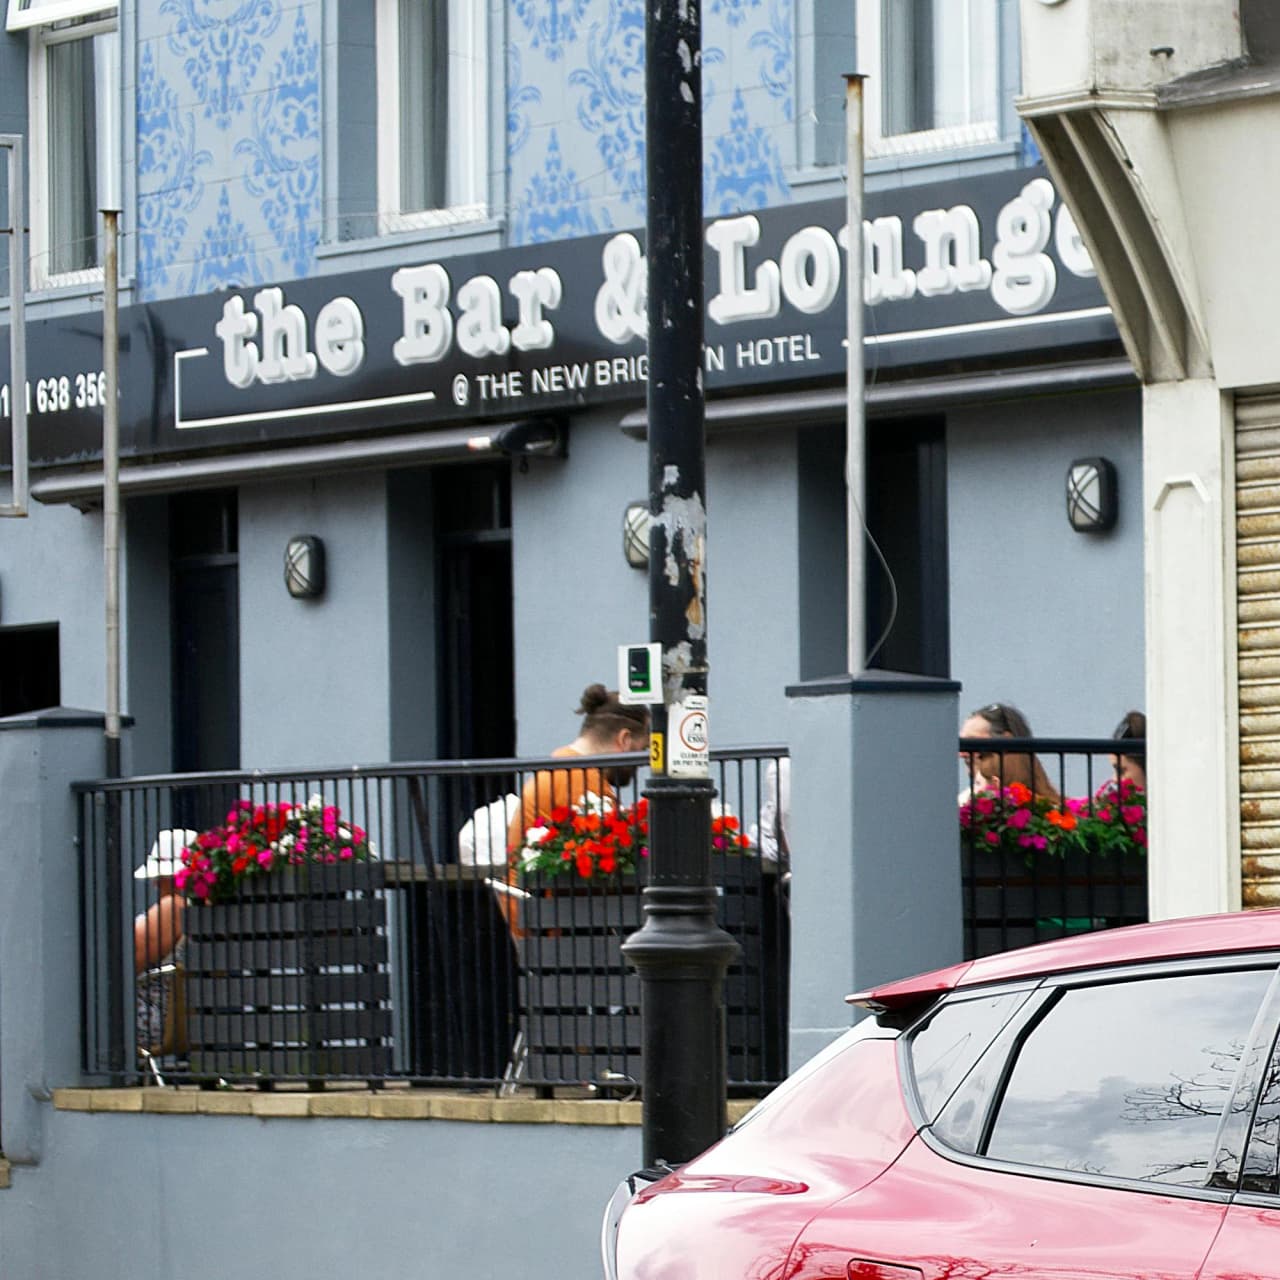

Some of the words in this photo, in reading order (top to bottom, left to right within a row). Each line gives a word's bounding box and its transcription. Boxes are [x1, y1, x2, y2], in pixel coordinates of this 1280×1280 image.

[216, 287, 365, 389] the
[392, 262, 563, 366] Bar
[595, 232, 649, 345] &
[37, 378, 70, 413] 638
[75, 371, 121, 408] 356
[453, 373, 469, 405] @
[476, 371, 523, 399] THE
[531, 362, 590, 394] NEW
[595, 345, 725, 385] BRIGN
[736, 333, 821, 368] HOTEL
